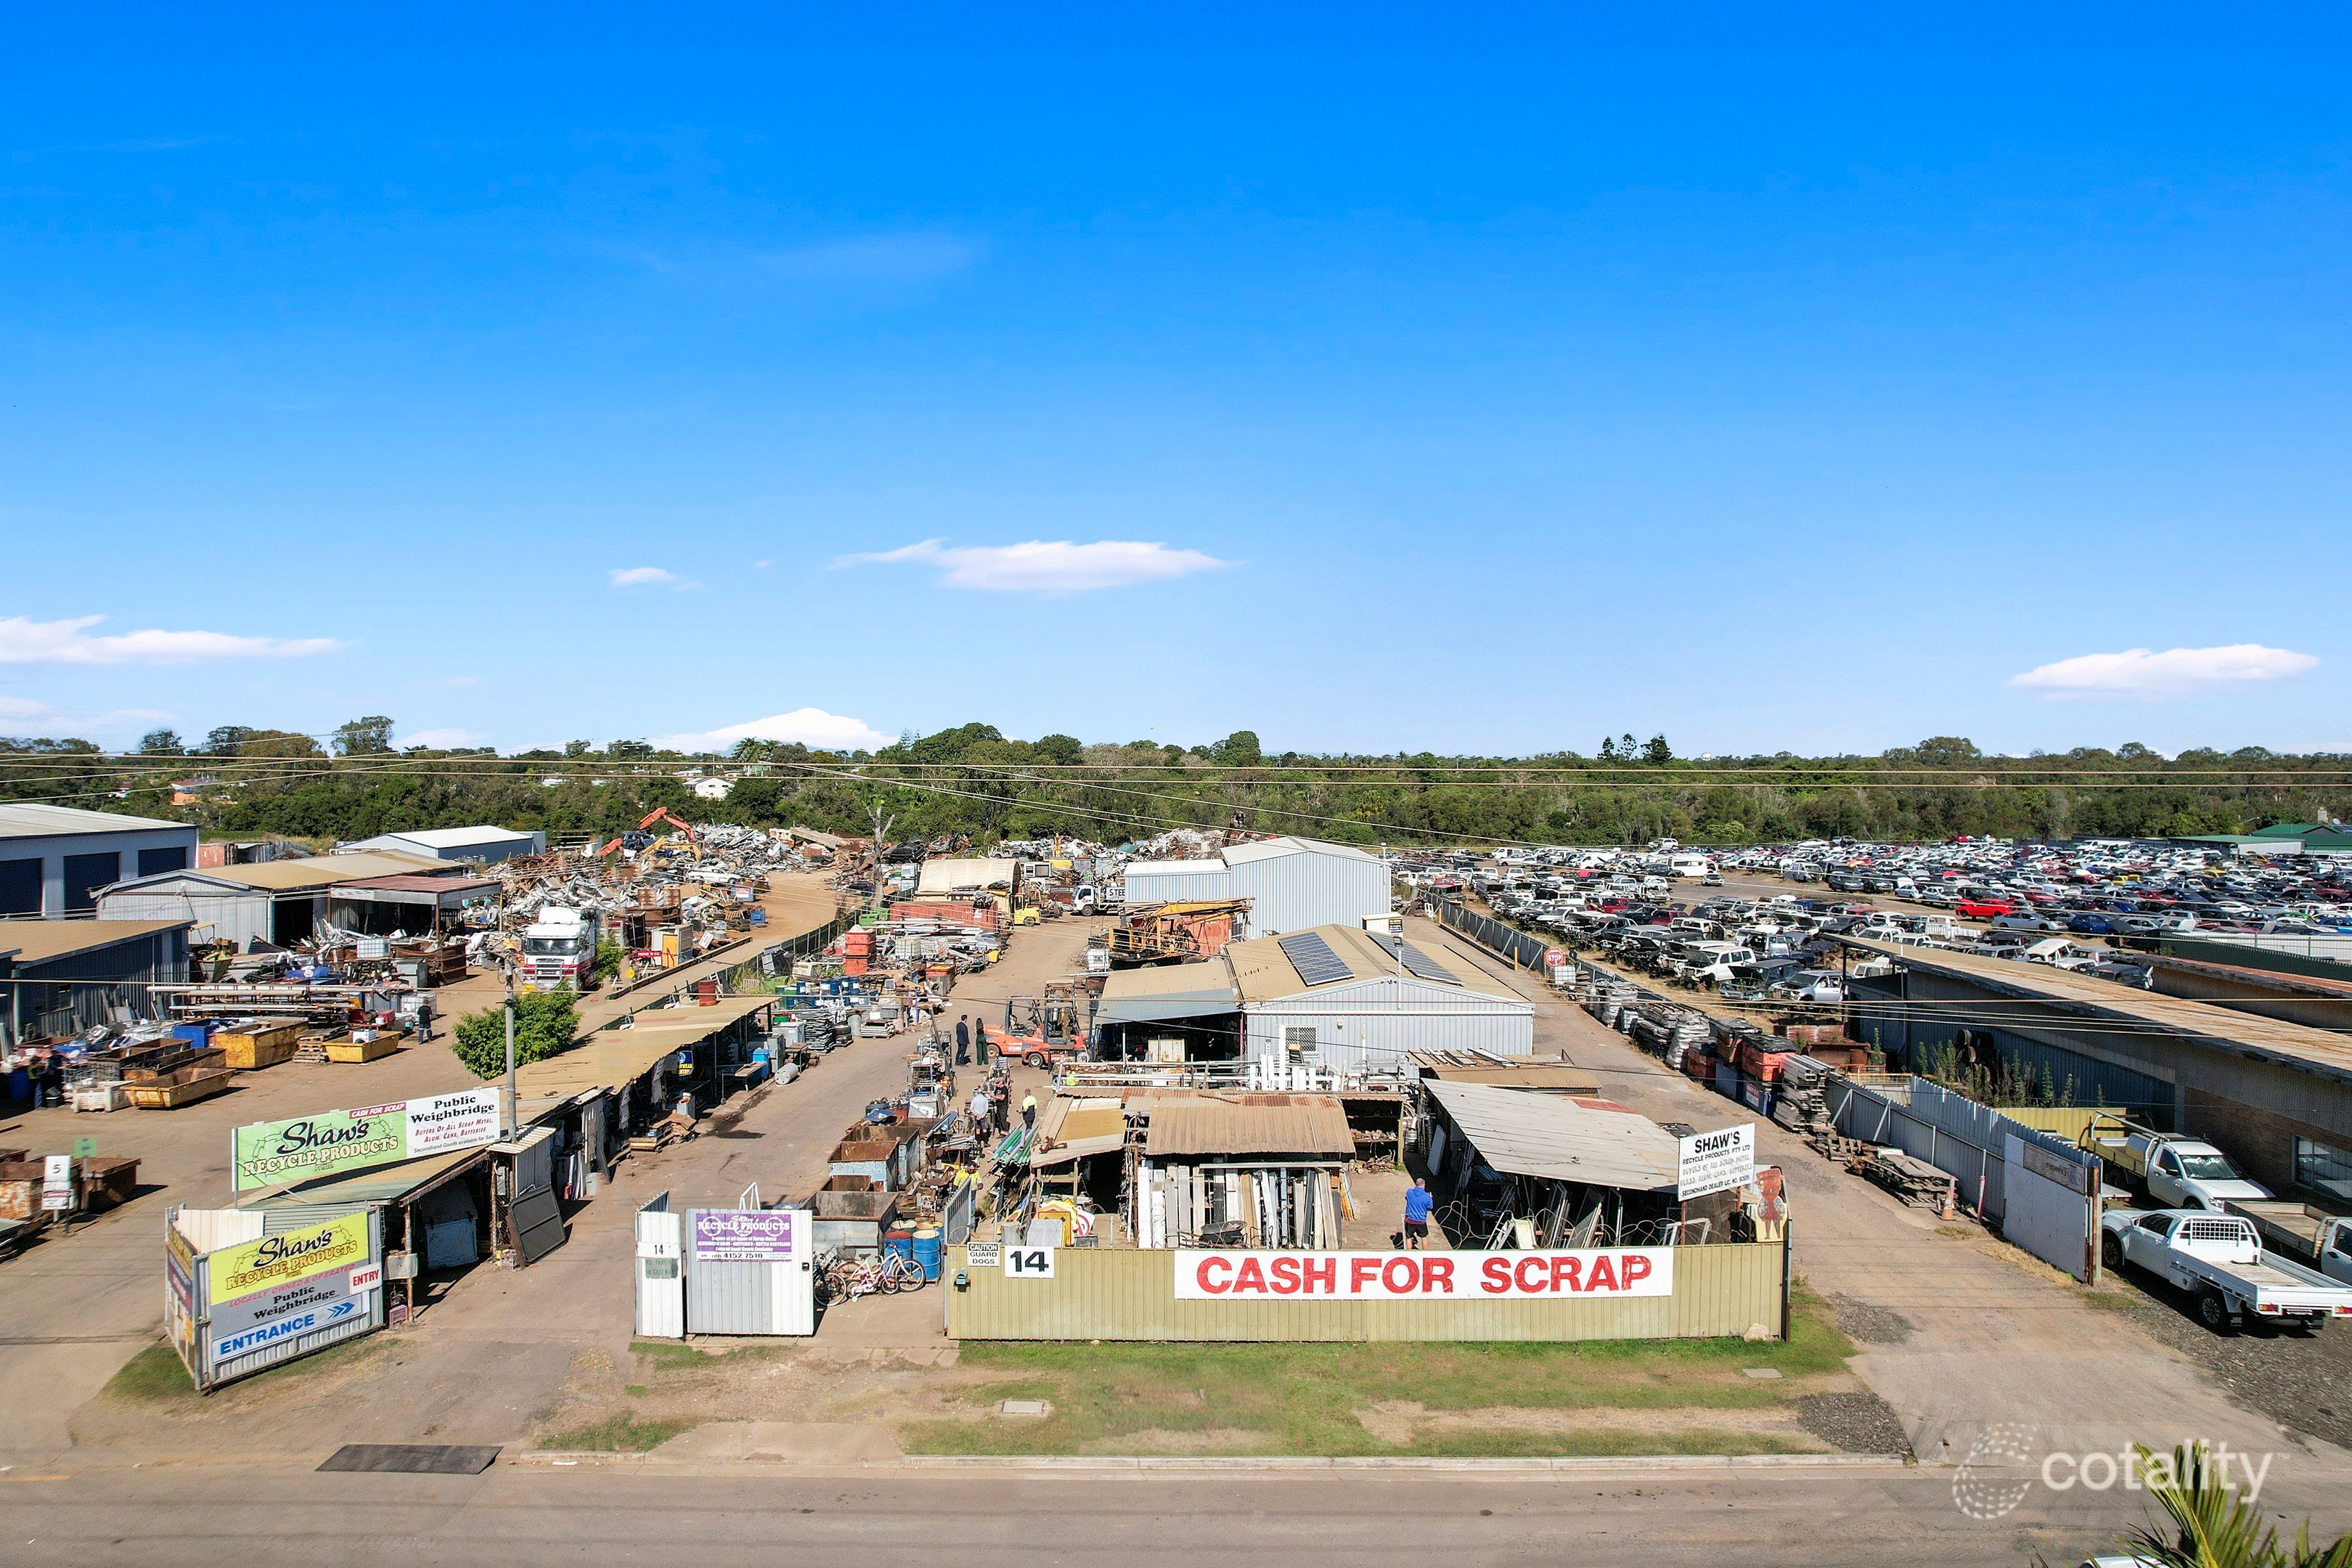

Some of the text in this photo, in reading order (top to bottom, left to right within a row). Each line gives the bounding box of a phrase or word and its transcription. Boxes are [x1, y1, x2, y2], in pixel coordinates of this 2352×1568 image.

[351, 1103, 405, 1119] CASH FOR SCRAP
[434, 1095, 476, 1109] Public
[410, 1103, 494, 1124] Weighbridge
[276, 1119, 369, 1154] Shaw's
[414, 1143, 442, 1153] Secondhand
[458, 1137, 478, 1146] available
[1695, 1131, 1741, 1153] SHAW'S
[243, 1136, 399, 1177] RECYCLE PRODUCTS
[1683, 1155, 1704, 1165] RECYCLE
[1704, 1149, 1730, 1160] PRODUCTS
[1719, 1159, 1734, 1167] SCRAP
[52, 1164, 61, 1174] 5
[1682, 1185, 1707, 1197] SECONDHAND
[1709, 1181, 1723, 1190] DEALER
[698, 1221, 790, 1231] RECYCLE PRODUCTS
[253, 1229, 332, 1267] Shaw's
[655, 1244, 663, 1254] 14
[226, 1259, 290, 1290] RECYCLE
[290, 1241, 358, 1270] PRODUCTS
[1010, 1251, 1049, 1272] 14
[352, 1269, 380, 1287] ENTRY
[1196, 1255, 1651, 1294] CASH FOR SCRAP
[228, 1290, 269, 1307] LOCALLY
[271, 1280, 303, 1295] OWNED
[312, 1264, 355, 1283] OPERATED
[273, 1286, 315, 1304] Public
[253, 1289, 335, 1320] Weighbridge
[219, 1312, 315, 1355] ENTRANCE
